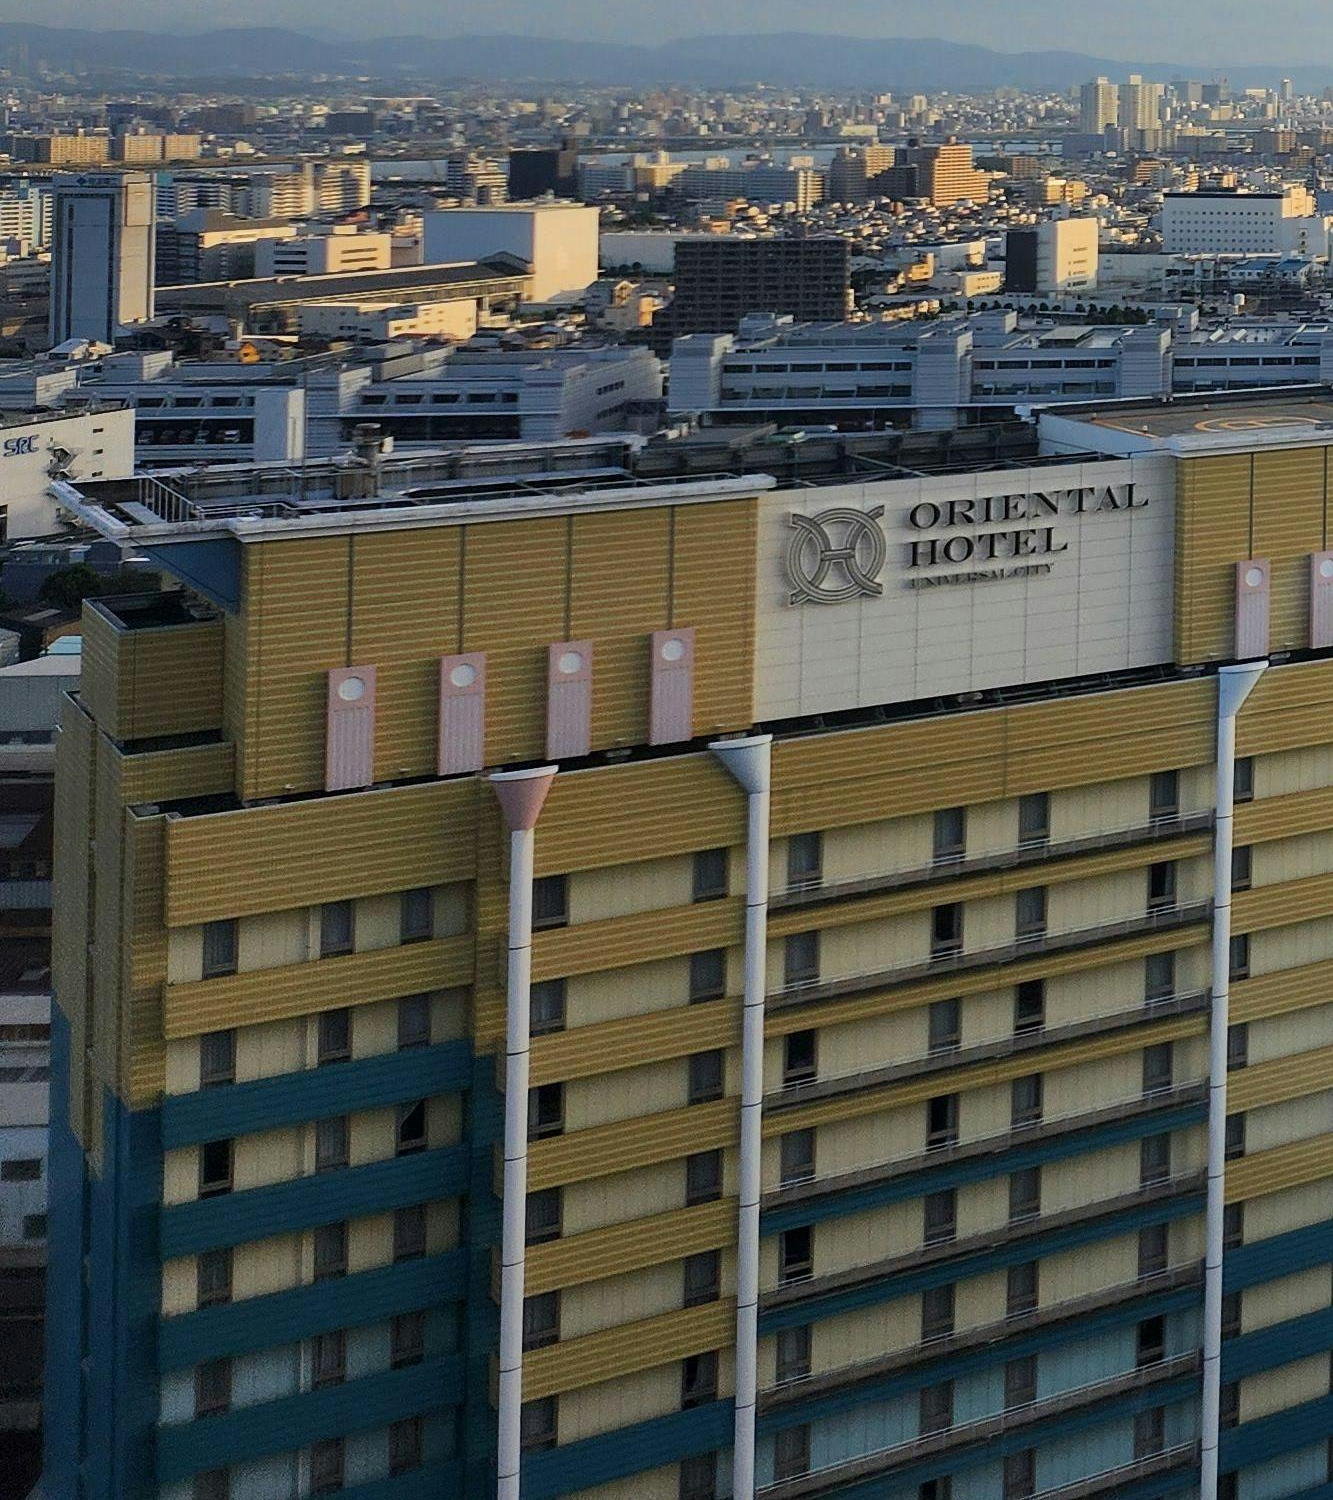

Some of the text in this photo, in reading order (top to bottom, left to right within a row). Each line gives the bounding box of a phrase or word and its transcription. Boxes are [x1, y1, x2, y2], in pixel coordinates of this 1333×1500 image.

[909, 482, 1149, 530] ORIENTAL
[909, 526, 1068, 567] HOTEL
[910, 562, 1055, 590] UNIVERSAL CITY
